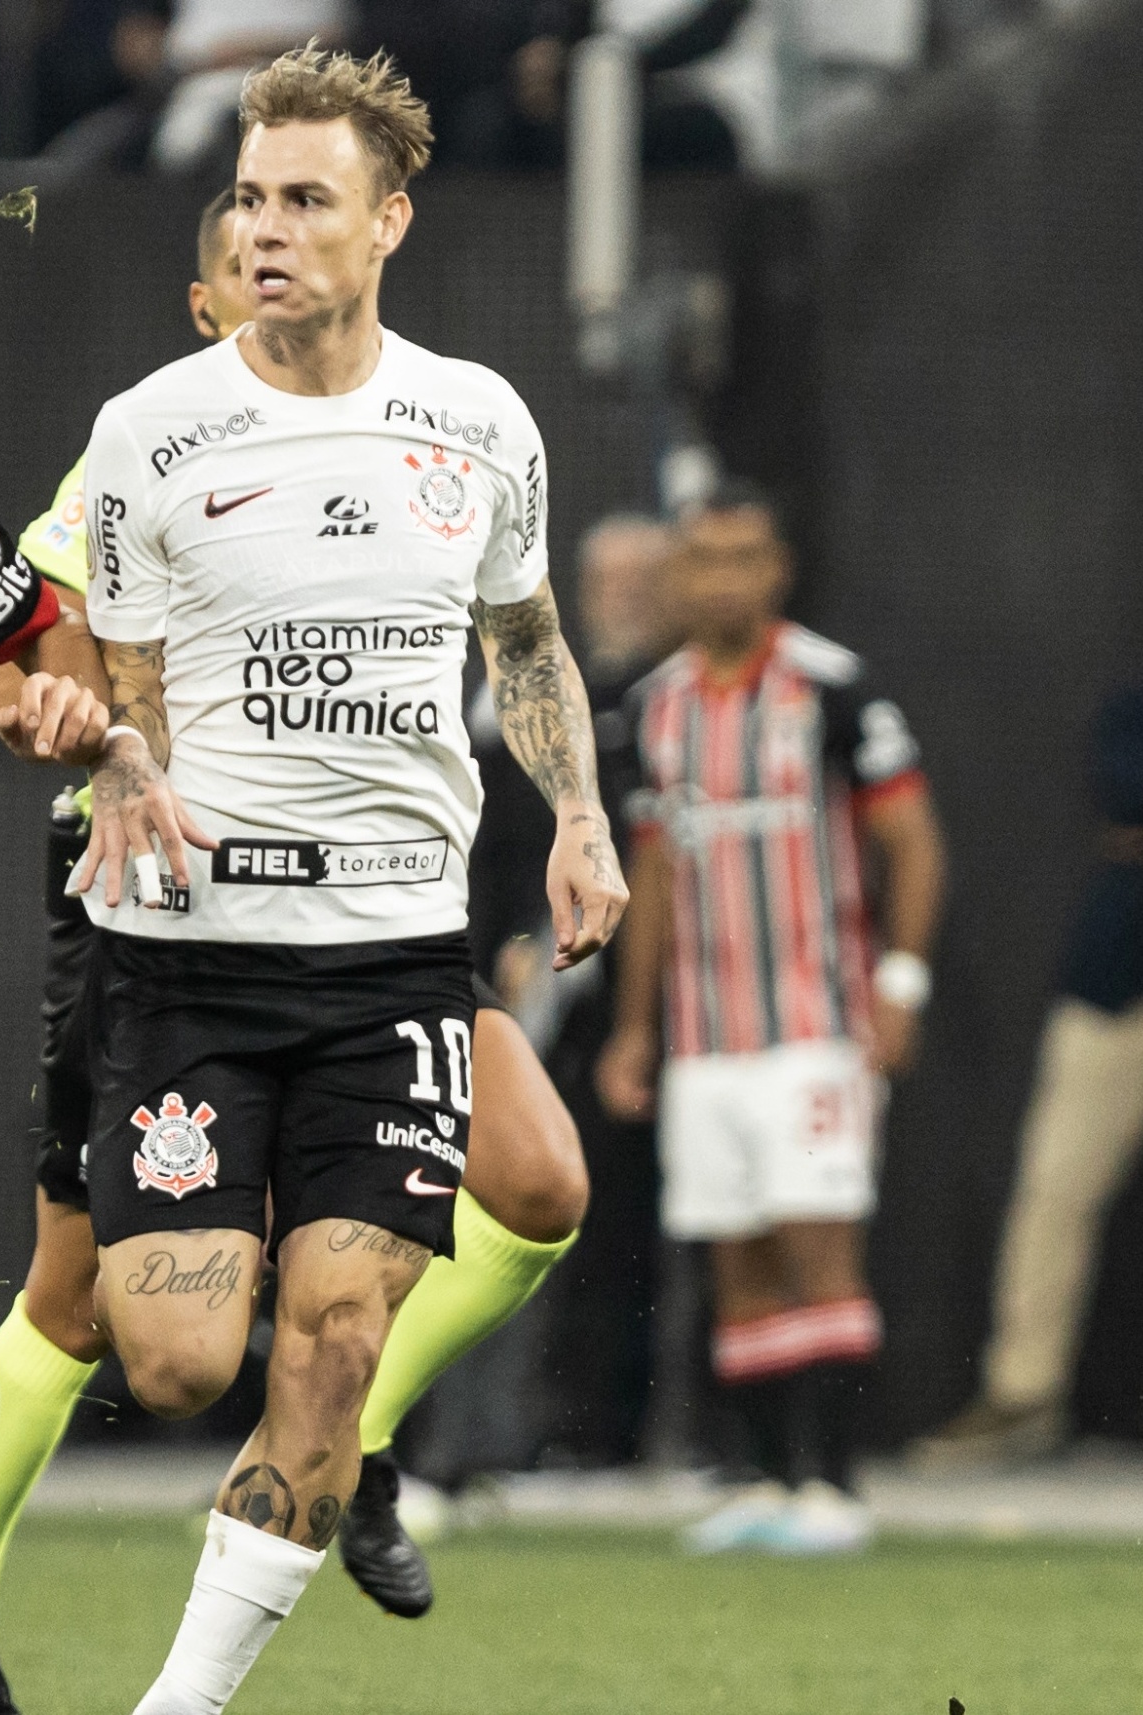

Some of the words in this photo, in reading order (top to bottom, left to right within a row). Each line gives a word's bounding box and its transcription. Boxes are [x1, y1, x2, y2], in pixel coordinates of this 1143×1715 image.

[150, 407, 267, 478] pixbet
[384, 399, 500, 454] pixbet
[101, 491, 127, 577] bmg
[316, 522, 379, 537] ALE
[243, 618, 444, 652] vitaminas
[243, 654, 353, 688] neo
[242, 689, 439, 740] química
[228, 847, 310, 877] FIEL
[339, 852, 437, 872] torcedor
[395, 1017, 473, 1116] 10
[124, 1249, 242, 1310] Daddy
